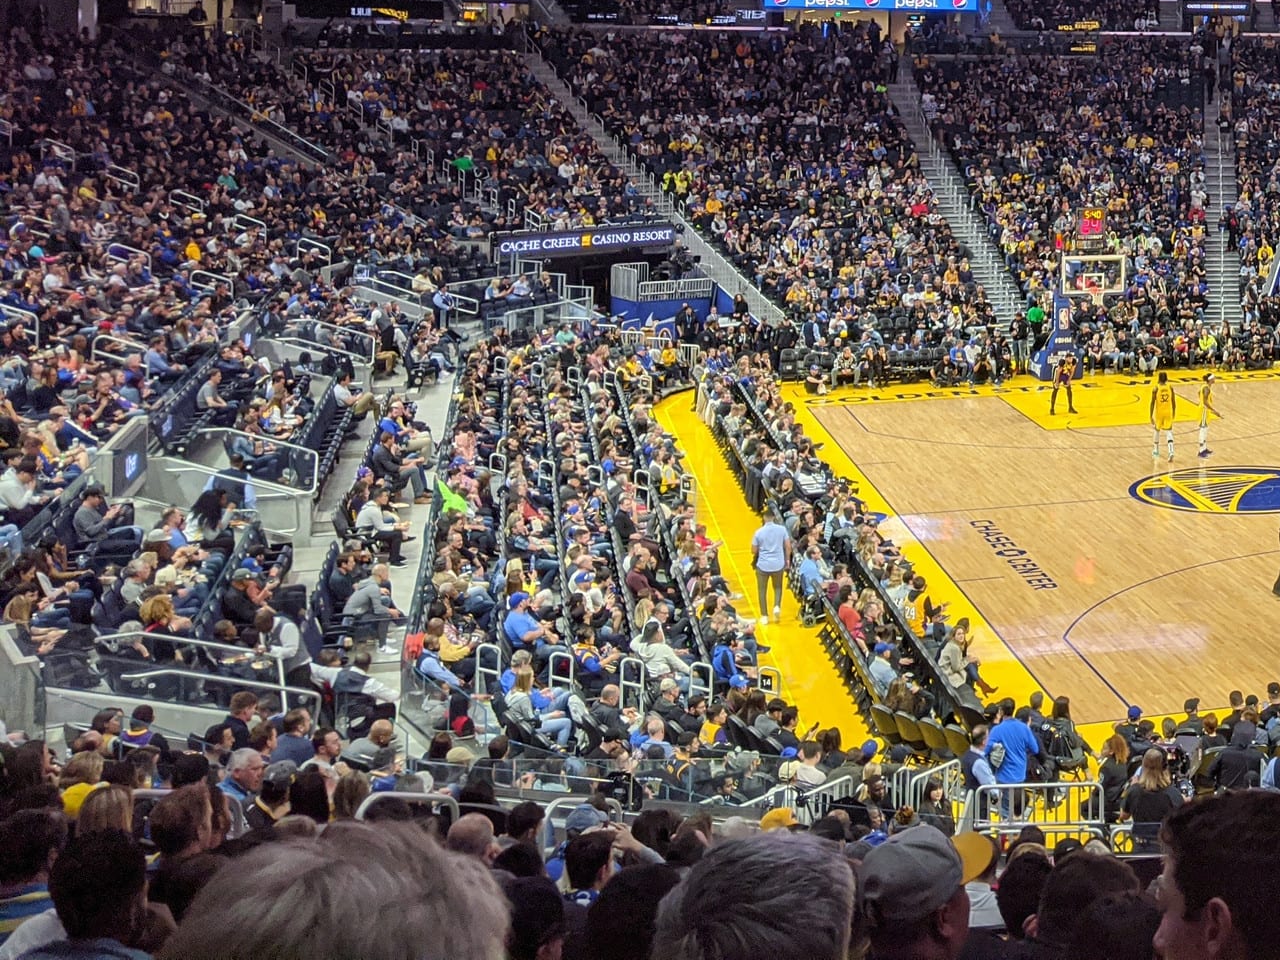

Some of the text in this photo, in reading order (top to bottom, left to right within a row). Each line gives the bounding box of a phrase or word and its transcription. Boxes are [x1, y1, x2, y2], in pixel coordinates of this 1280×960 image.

[500, 229, 672, 253] CACHE CREEK CASINO RESORT
[1159, 393, 1170, 403] 32
[969, 519, 1058, 591] CHASE CENTER
[904, 605, 916, 619] 24
[761, 677, 773, 688] 14
